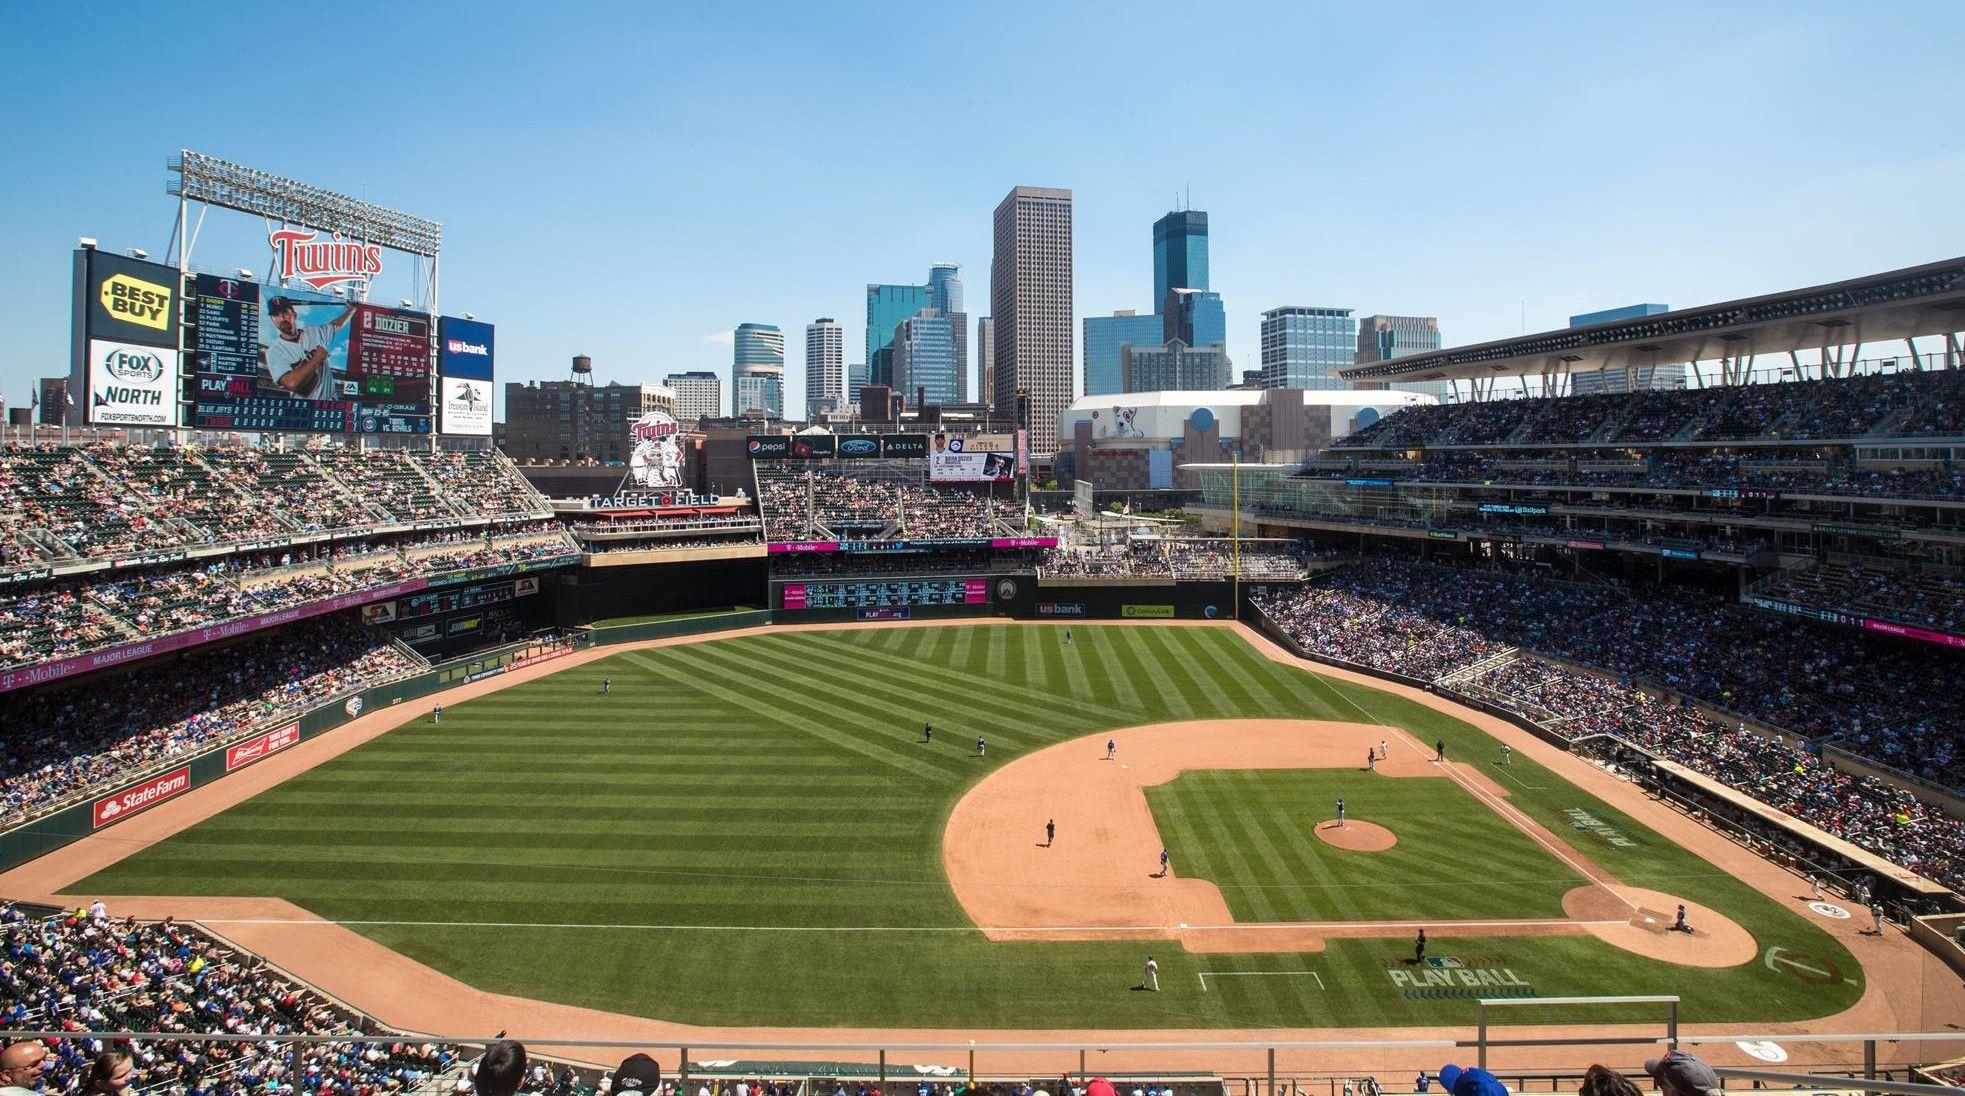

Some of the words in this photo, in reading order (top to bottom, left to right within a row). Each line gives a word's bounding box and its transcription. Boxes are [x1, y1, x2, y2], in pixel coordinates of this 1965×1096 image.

[270, 229, 383, 279] Twins
[111, 281, 169, 309] BEST
[112, 297, 163, 321] BUY
[375, 317, 409, 334] DOZIER
[118, 353, 152, 372] FOX
[118, 369, 153, 379] SPORTS
[202, 379, 227, 391] PLAY
[105, 386, 162, 405] NORTH
[198, 405, 214, 413] BLUE
[101, 412, 167, 423] FOXSPORTSNORTH.COM
[633, 420, 679, 442] Twins
[761, 443, 786, 451] pepsi
[847, 440, 869, 451] Ford
[593, 496, 659, 508] TARGET
[675, 494, 720, 506] FIELD
[158, 554, 169, 562] Run
[169, 552, 185, 561] Porch
[13, 573, 28, 582] Run
[29, 569, 48, 580] Porch
[1039, 603, 1082, 614] usbank
[1136, 607, 1170, 616] CenturyLink
[260, 616, 280, 625] MAJOR
[280, 610, 300, 620] LEAGUE
[450, 618, 481, 631] SUBWAY
[93, 652, 122, 666] MAJOR
[122, 645, 153, 659] LEAGUE
[1387, 969, 1456, 987] PLAY
[1455, 968, 1530, 986] BALL
